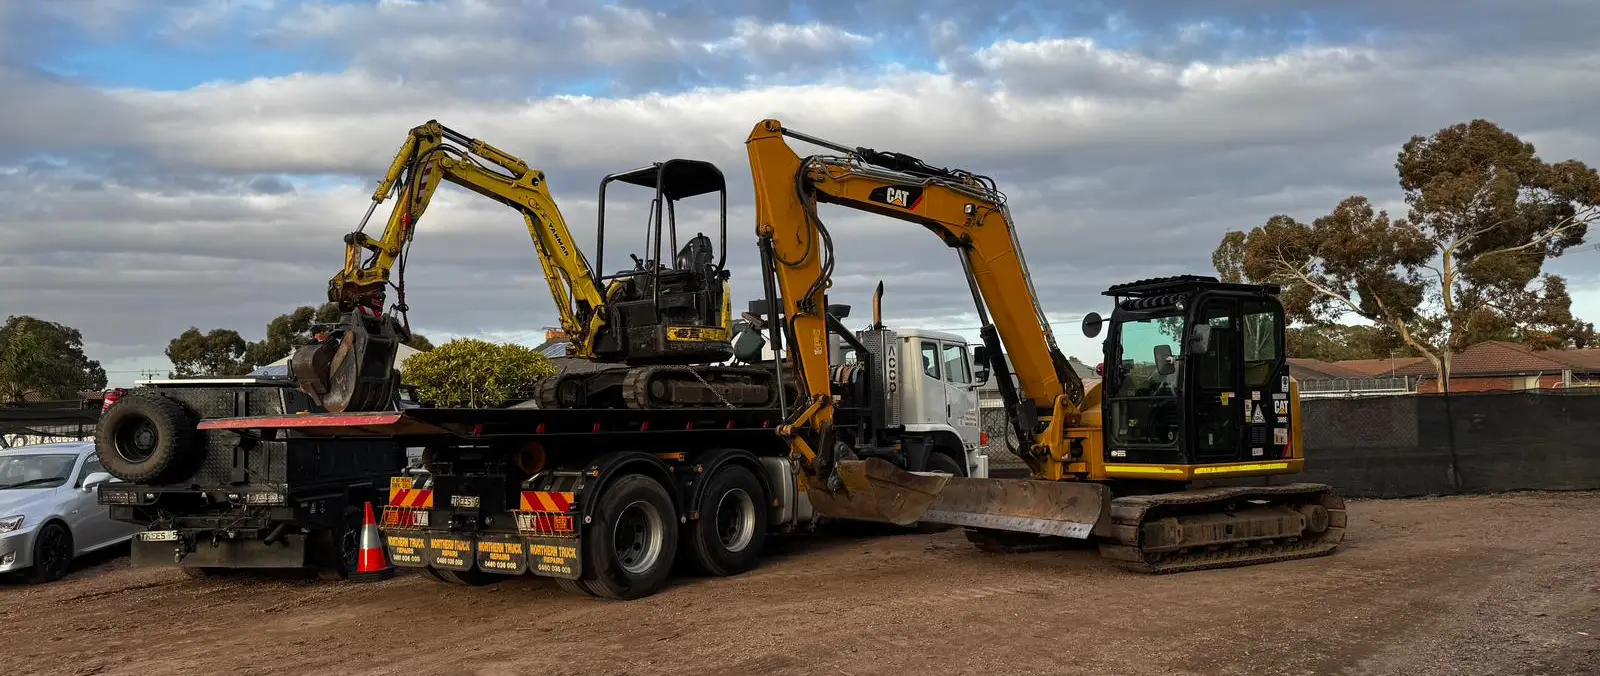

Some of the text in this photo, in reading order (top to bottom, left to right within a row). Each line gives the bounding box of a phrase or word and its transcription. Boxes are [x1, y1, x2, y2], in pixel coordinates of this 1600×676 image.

[886, 187, 910, 207] CAT
[548, 222, 570, 257] YANMAR
[888, 346, 896, 392] ACCO
[1274, 400, 1288, 414] CAT
[409, 538, 425, 548] TRUCK
[431, 539, 471, 551] NORTHERN TRUCK
[479, 542, 522, 554] NORTHERN TRUCK
[530, 544, 576, 558] NORTHERN TRUCK
